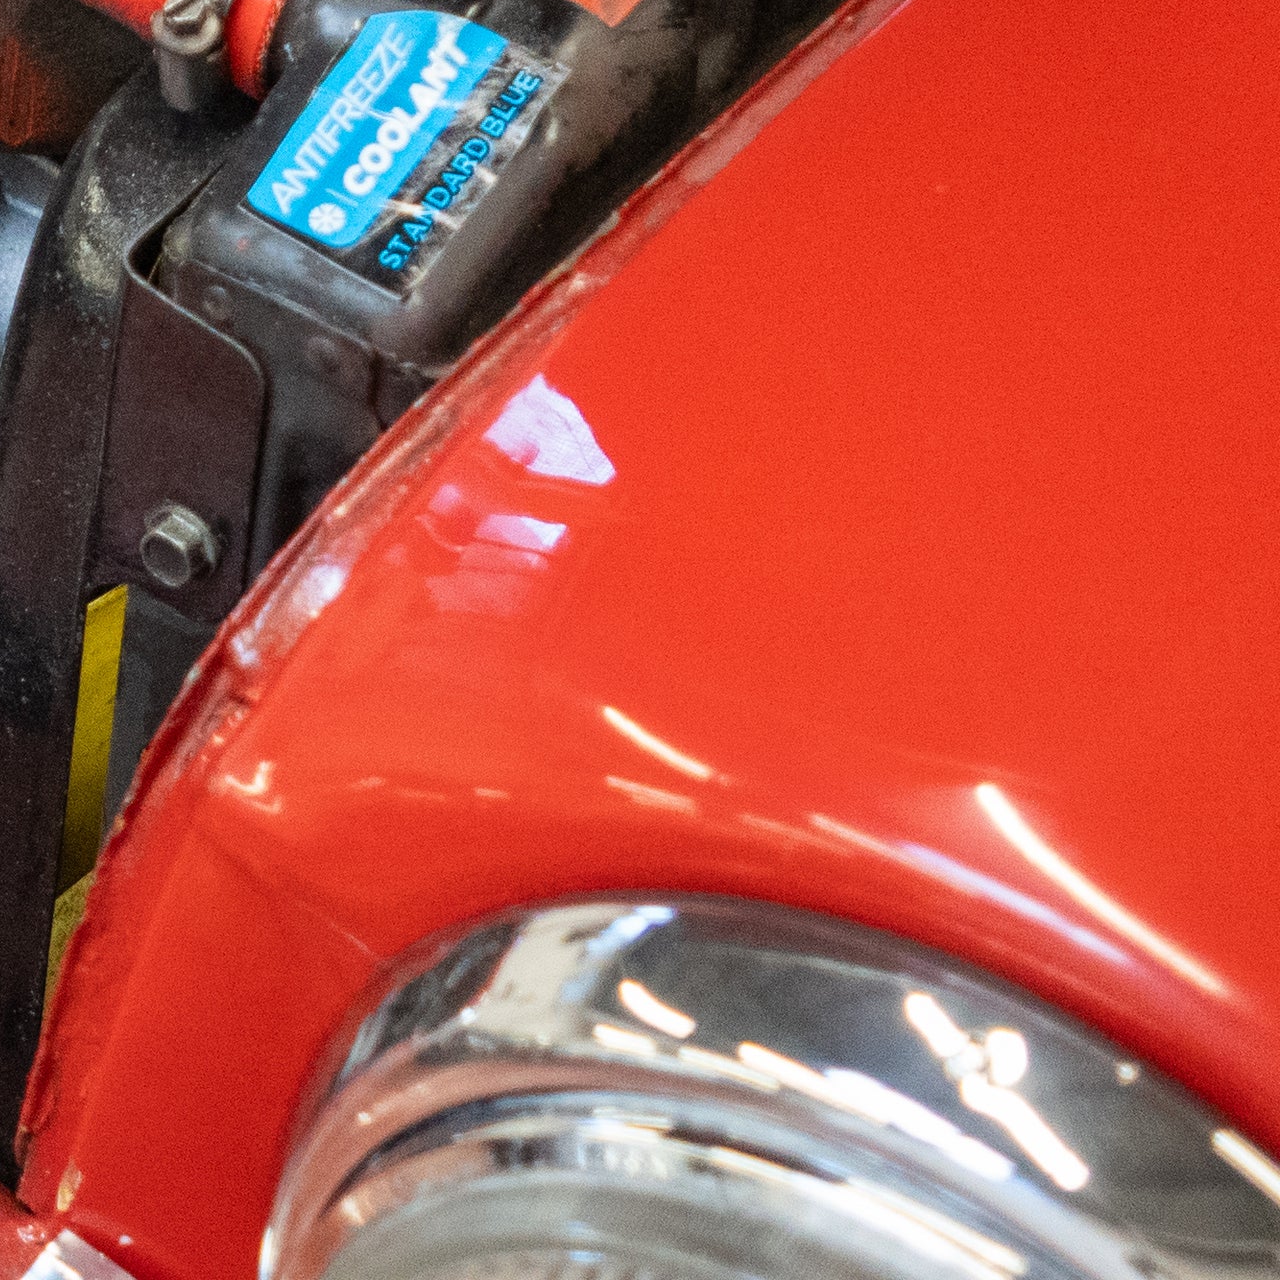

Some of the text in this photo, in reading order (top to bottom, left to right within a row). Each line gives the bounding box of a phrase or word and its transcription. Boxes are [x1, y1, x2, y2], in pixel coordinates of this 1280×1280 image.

[271, 22, 415, 217] ANTIFREEZE
[342, 31, 469, 197] COOLANT
[378, 69, 542, 272] STANDARD BLUE
